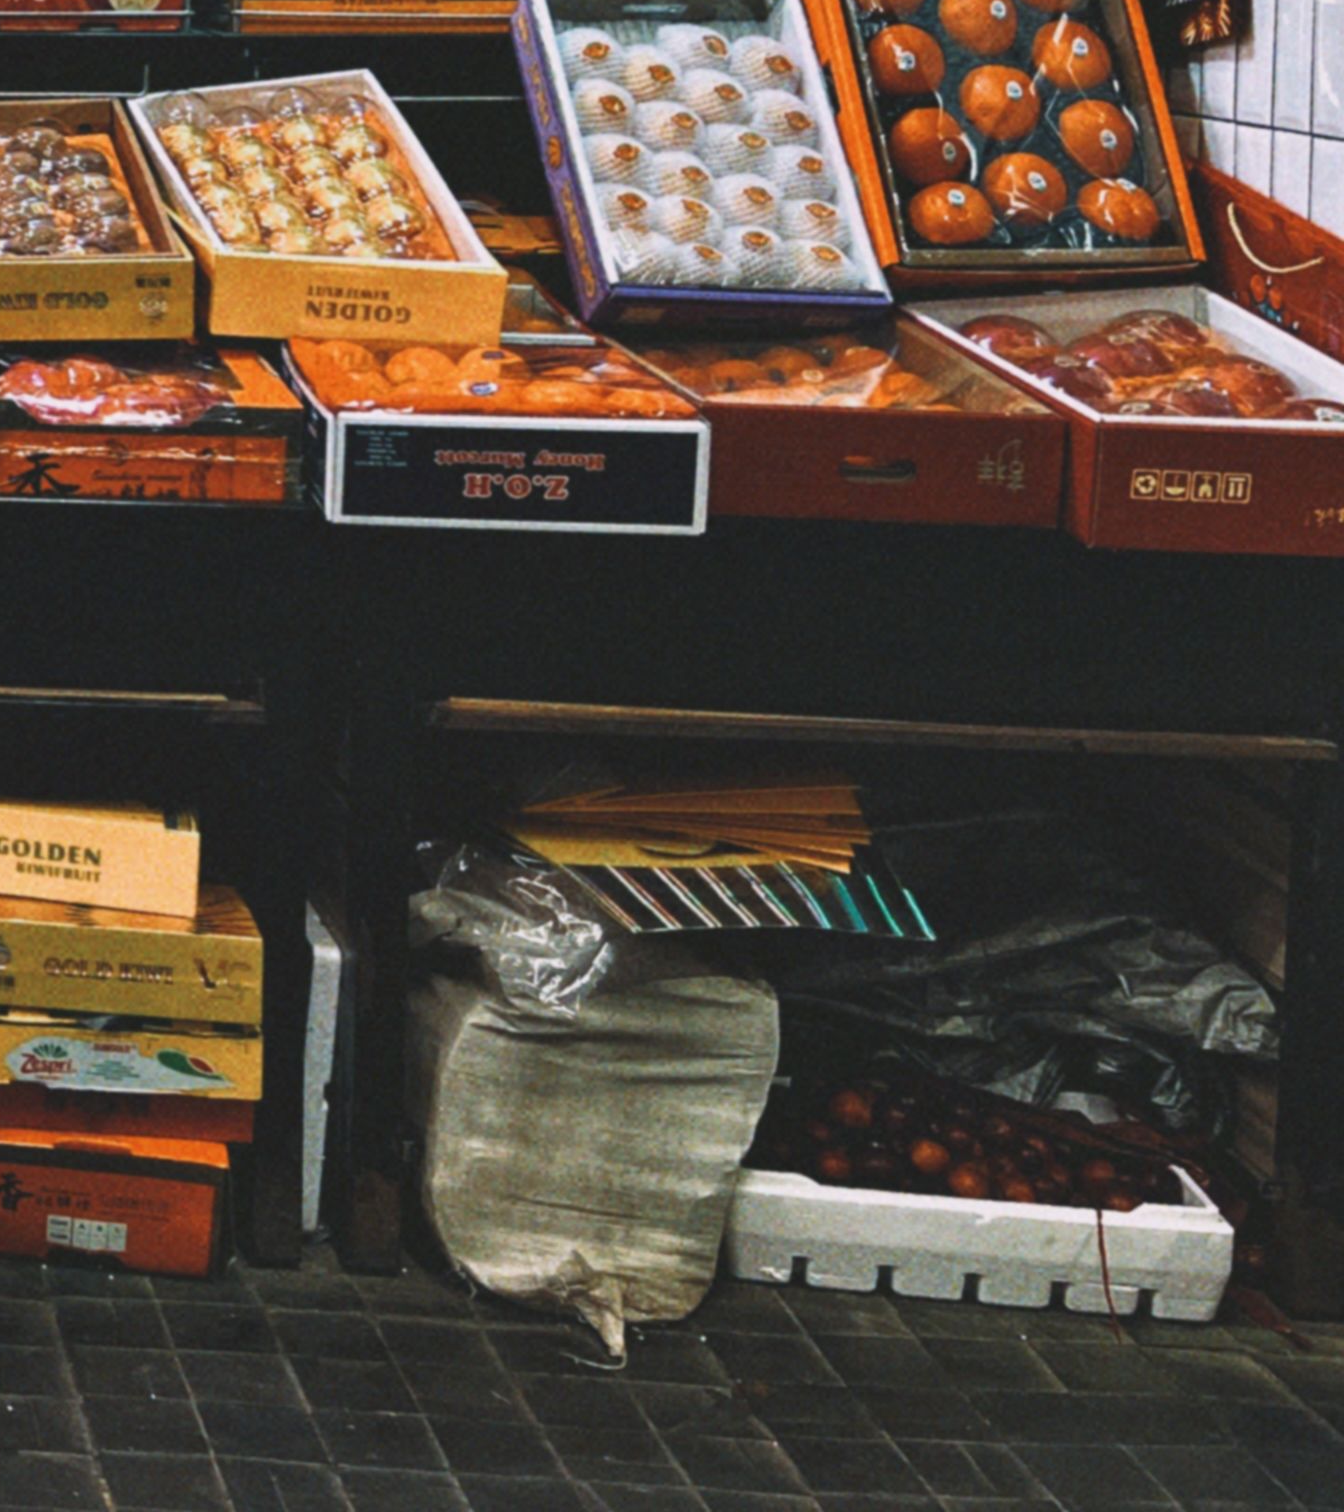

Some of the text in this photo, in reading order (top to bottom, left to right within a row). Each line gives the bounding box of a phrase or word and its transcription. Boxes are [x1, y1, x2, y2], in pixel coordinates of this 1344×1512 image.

[44, 291, 110, 311] GOLD
[305, 300, 412, 325] GOLDEN
[443, 449, 606, 472] Honey Murcott
[461, 473, 570, 500] Z.O.H
[43, 957, 113, 981] GOLD
[20, 1051, 74, 1076] Zespri
